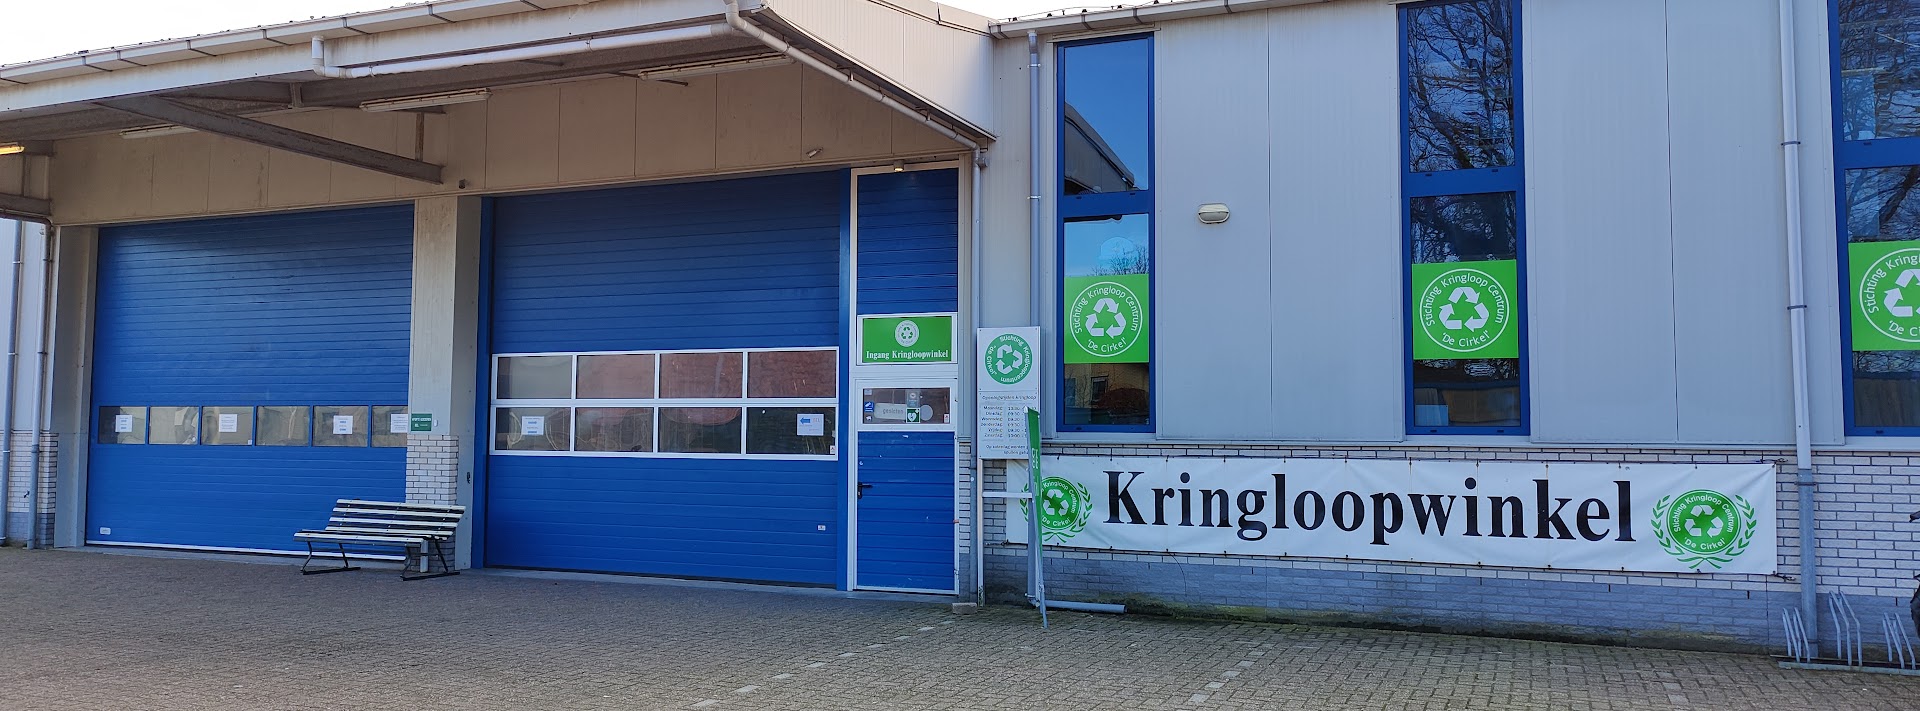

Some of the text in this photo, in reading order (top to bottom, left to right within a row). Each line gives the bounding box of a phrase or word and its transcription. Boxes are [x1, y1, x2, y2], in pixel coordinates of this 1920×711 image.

[1072, 286, 1139, 334] Stichting Kringloop Centrum
[1423, 273, 1504, 326] Stichting Kringloop Centrum
[1864, 267, 1887, 314] Stichting
[866, 349, 949, 361] Ingang Kringloopwinkel
[1042, 481, 1069, 490] Kringloop
[1102, 470, 1637, 546] Kringloopwinkel
[1672, 494, 1735, 533] Stichting Kringloop Centrum
